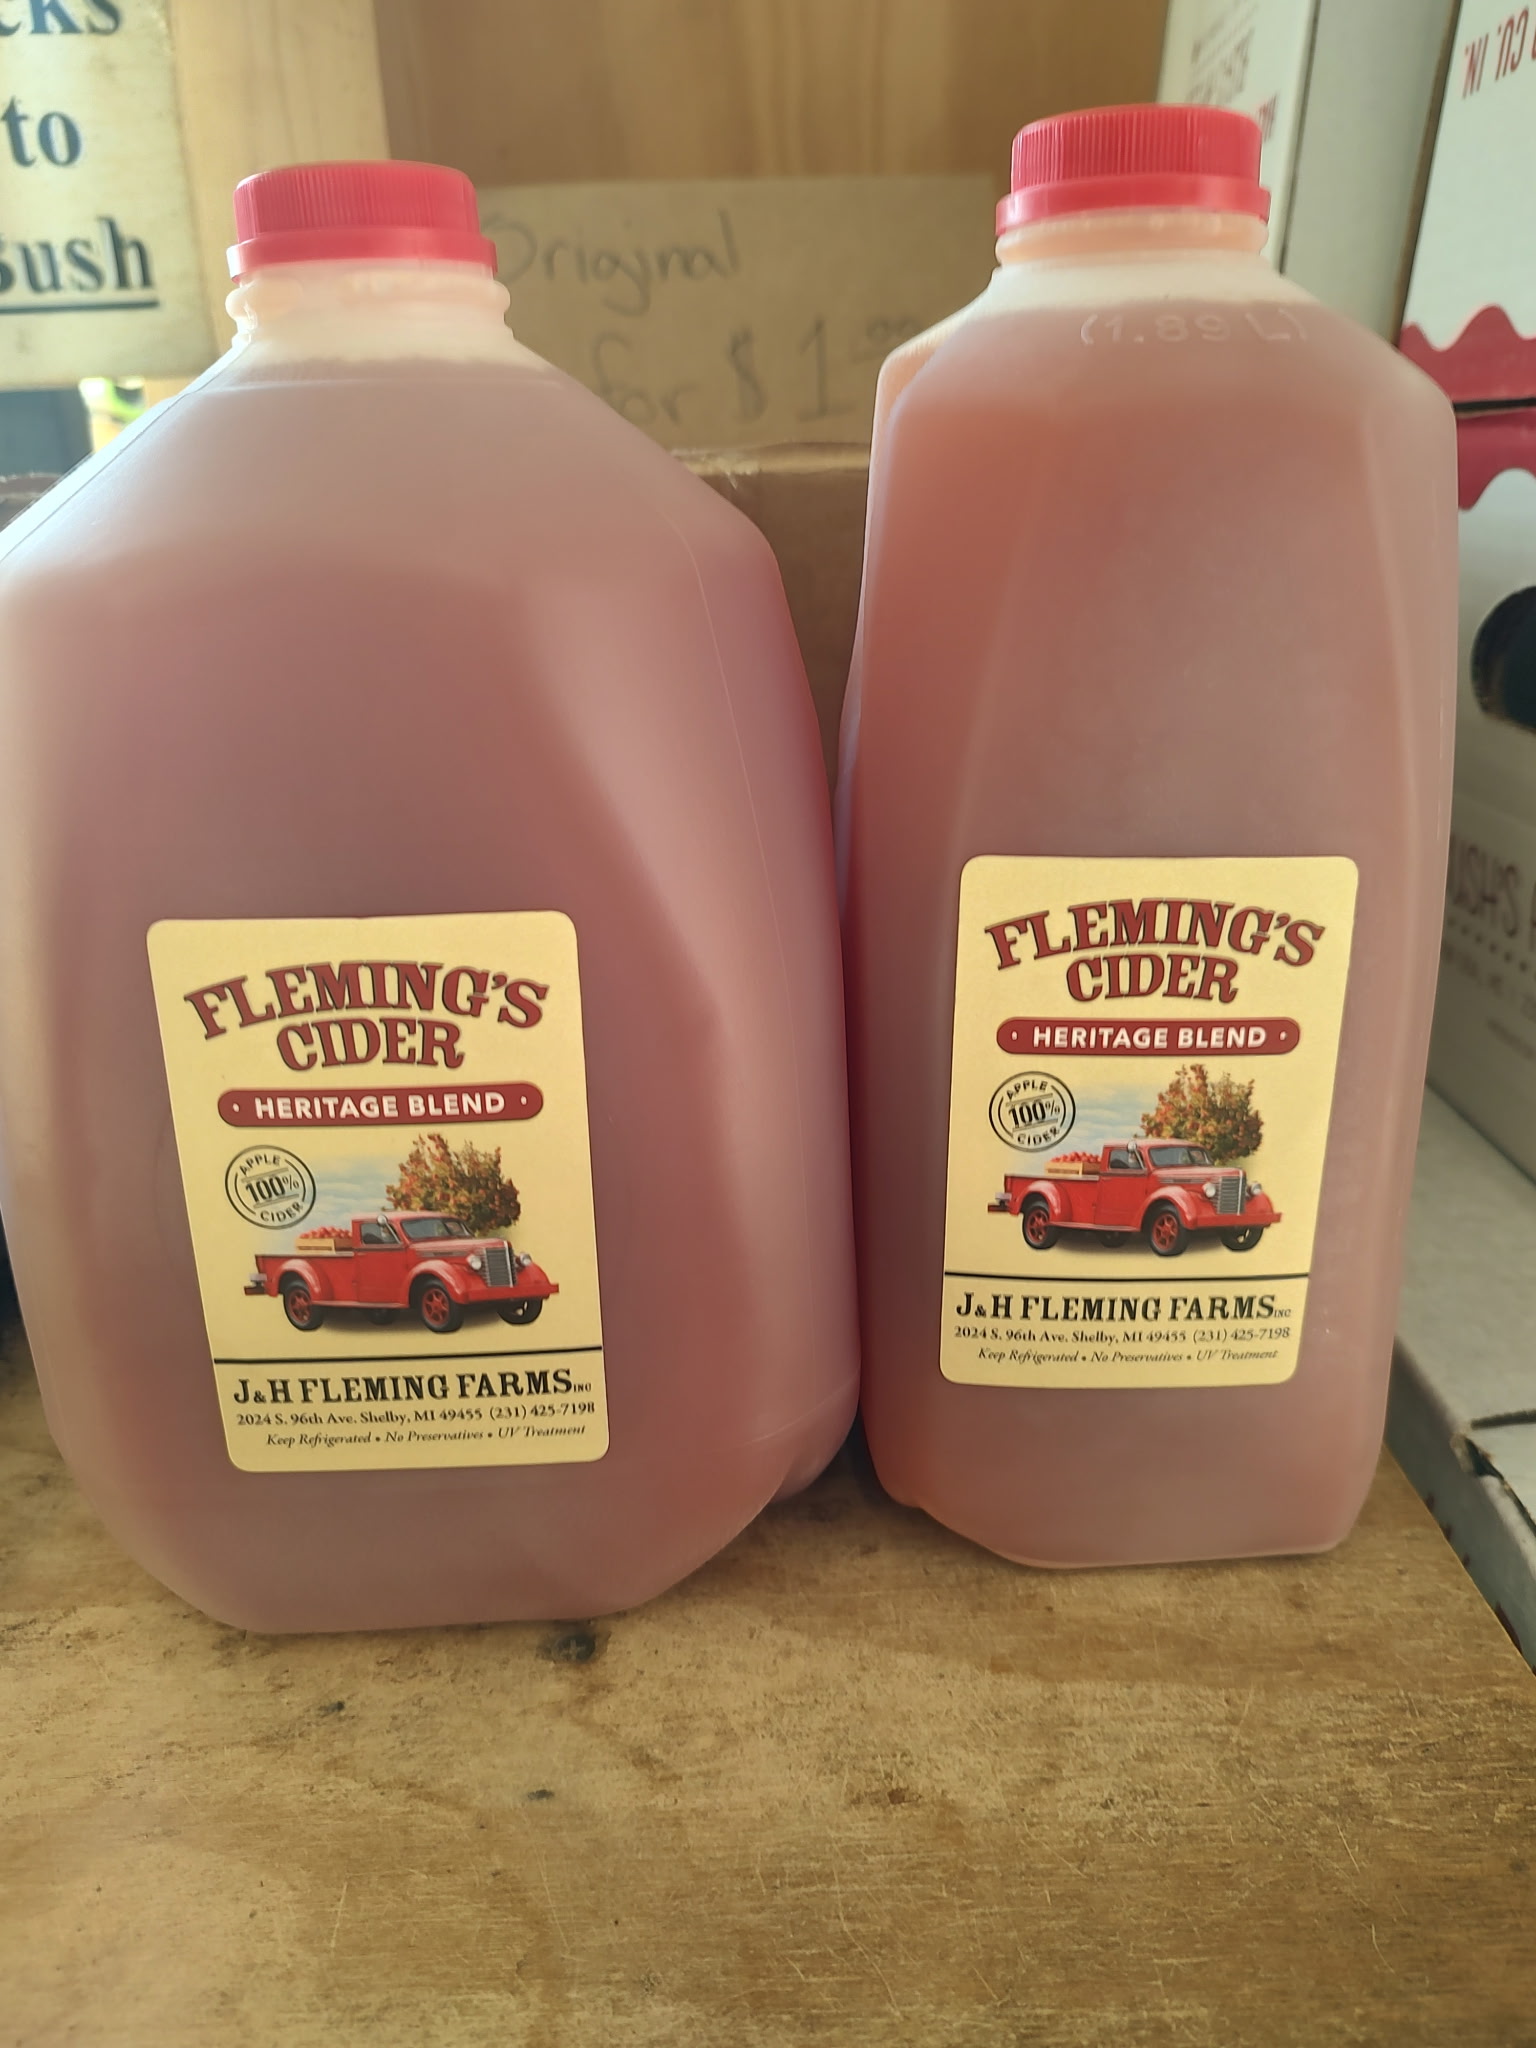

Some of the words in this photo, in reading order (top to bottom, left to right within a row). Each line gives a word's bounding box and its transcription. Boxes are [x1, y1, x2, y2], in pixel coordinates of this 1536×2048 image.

[2, 96, 82, 167] to
[984, 897, 1326, 971] FLEMING'S
[1066, 952, 1239, 1005] CIDER
[184, 960, 551, 1041] FLEMING'S
[276, 1017, 465, 1072] CIDER
[1032, 1025, 1168, 1049] HERITAGE
[1177, 1026, 1267, 1049] BLEND
[1006, 1079, 1048, 1102] APPLE
[253, 1095, 399, 1121] HERITAGE
[407, 1091, 505, 1118] BLEND
[1008, 1099, 1061, 1129] 100%
[1016, 1126, 1060, 1147] CIDER
[239, 1152, 281, 1176] APPLE
[245, 1173, 300, 1203] 100%
[260, 1201, 303, 1223] CIDER
[956, 1291, 1013, 1319] J&H
[1020, 1295, 1161, 1322] FLEMING
[1168, 1294, 1275, 1322] FARMS
[954, 1326, 987, 1340] 2024
[1005, 1329, 1036, 1342] 96th
[1039, 1330, 1069, 1343] Ave.
[1071, 1330, 1119, 1346] Shelby,
[1122, 1331, 1142, 1343] MI
[1146, 1330, 1186, 1343] 49455
[1192, 1329, 1227, 1344] (231)
[1230, 1327, 1290, 1341] 425-7198
[978, 1347, 1006, 1363] Keep
[1009, 1350, 1079, 1366] Refrigerated
[1090, 1351, 1109, 1362] No
[1112, 1351, 1183, 1363] Preservatives
[1196, 1350, 1219, 1361] UV
[1220, 1349, 1278, 1361] Treatment
[233, 1378, 294, 1404] J&H
[298, 1374, 450, 1404] FLEMING
[456, 1368, 573, 1399] FARMS
[236, 1412, 272, 1426] 2024
[290, 1412, 323, 1425] 96th
[327, 1412, 357, 1425] Ave.
[359, 1410, 411, 1426] Shelby,
[414, 1410, 436, 1421] MI
[439, 1408, 483, 1421] 49455
[489, 1405, 527, 1421] (231)
[530, 1401, 595, 1417] 425-7198
[266, 1433, 296, 1448] Keep
[299, 1431, 372, 1448] Refrigerated
[385, 1431, 404, 1443] No
[407, 1430, 484, 1441] Preservatives
[498, 1426, 522, 1438] UV
[523, 1424, 586, 1438] Treatment
